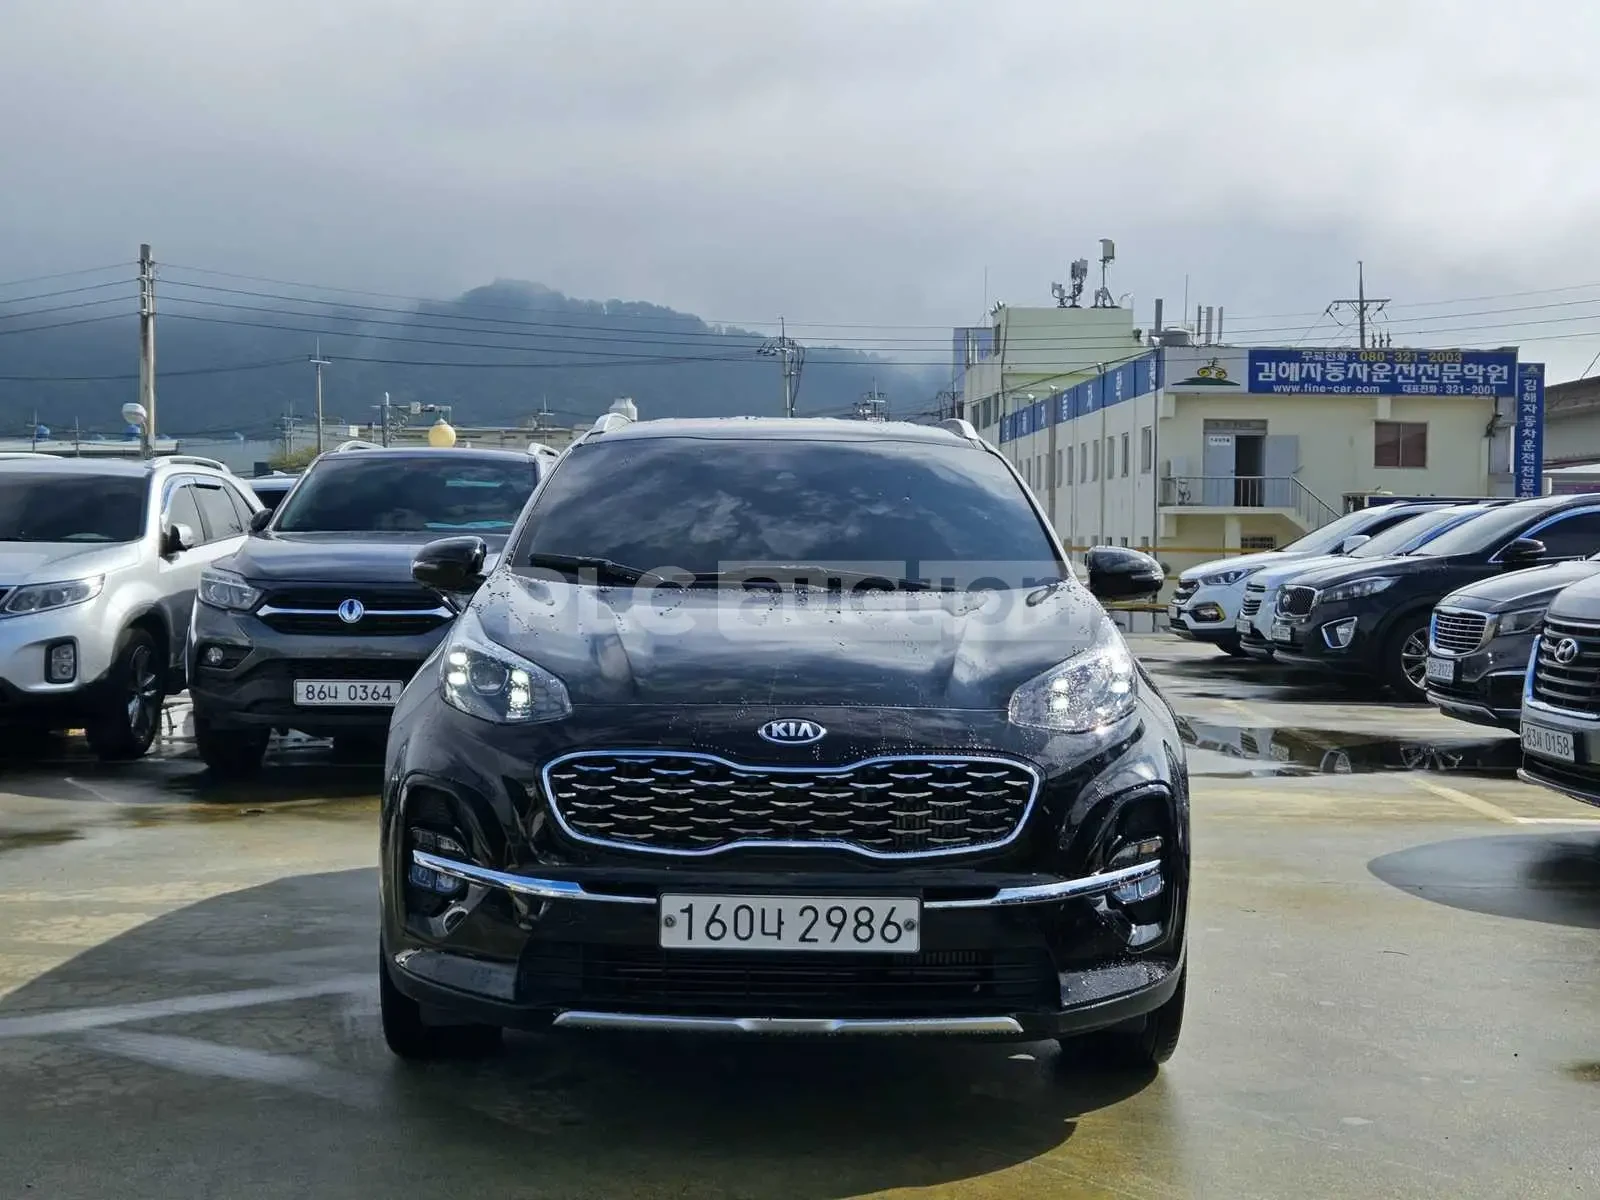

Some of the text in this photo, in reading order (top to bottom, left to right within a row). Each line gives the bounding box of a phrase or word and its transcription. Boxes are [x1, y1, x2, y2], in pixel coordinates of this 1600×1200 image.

[1360, 351, 1463, 362] 080-321-2003
[1256, 361, 1508, 384] 김해자동차운전전문학원
[1273, 383, 1380, 393] www.fine-car.com
[1445, 384, 1496, 394] 321-2001
[348, 684, 392, 701] 0364
[771, 722, 814, 737] KIA
[1544, 732, 1570, 757] 0158
[679, 903, 902, 944] 160나 2986
